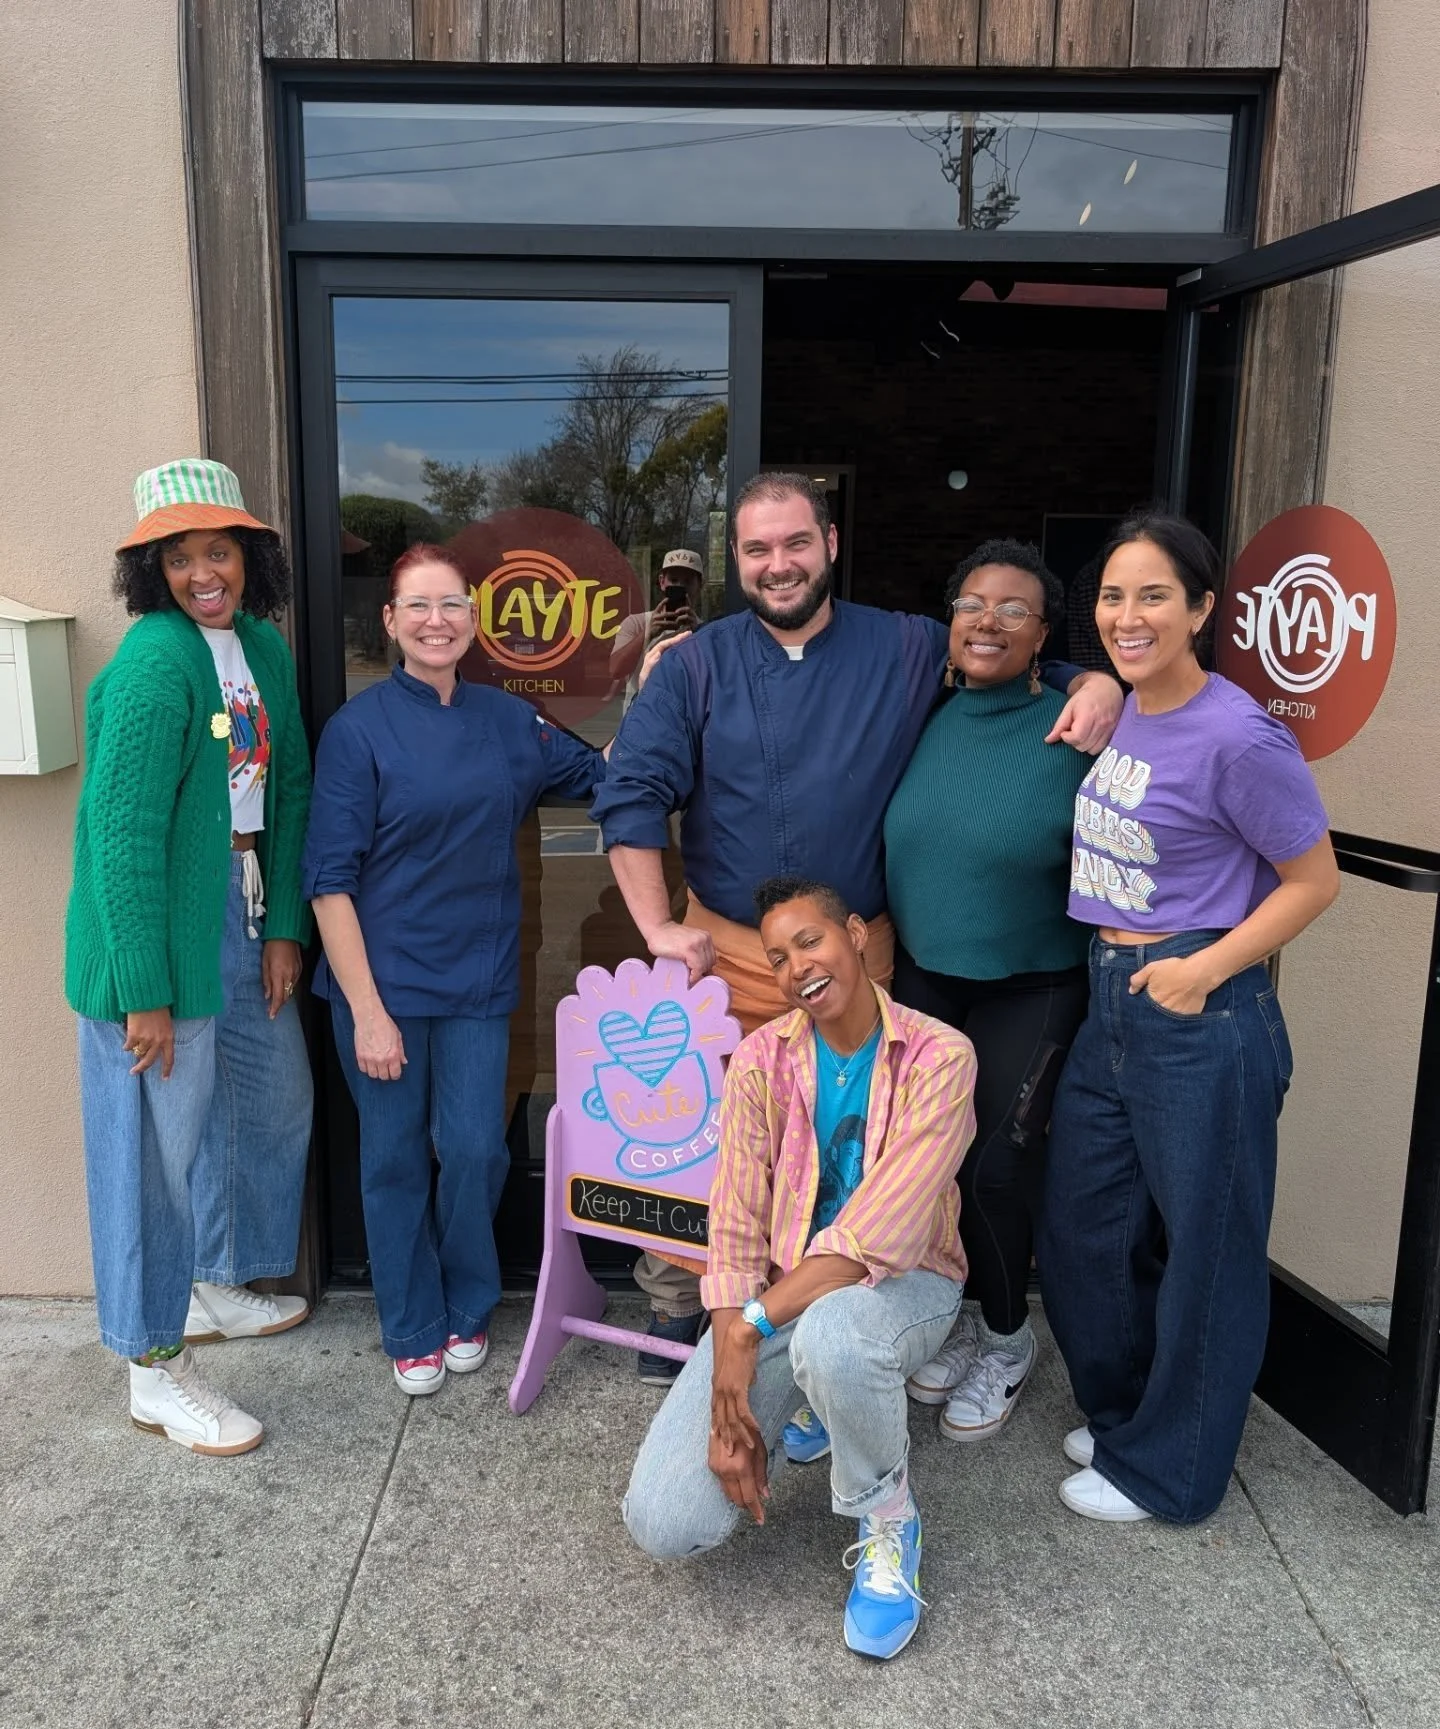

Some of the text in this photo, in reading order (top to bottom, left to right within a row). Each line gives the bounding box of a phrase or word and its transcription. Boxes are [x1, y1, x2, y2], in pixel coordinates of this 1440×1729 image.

[470, 580, 622, 641] LAYTE
[503, 679, 565, 693] KITCHEN
[1081, 746, 1151, 808] OOD
[1072, 848, 1155, 910] NLY
[615, 1080, 698, 1128] Cute
[579, 1179, 709, 1237] Keep It Cut
